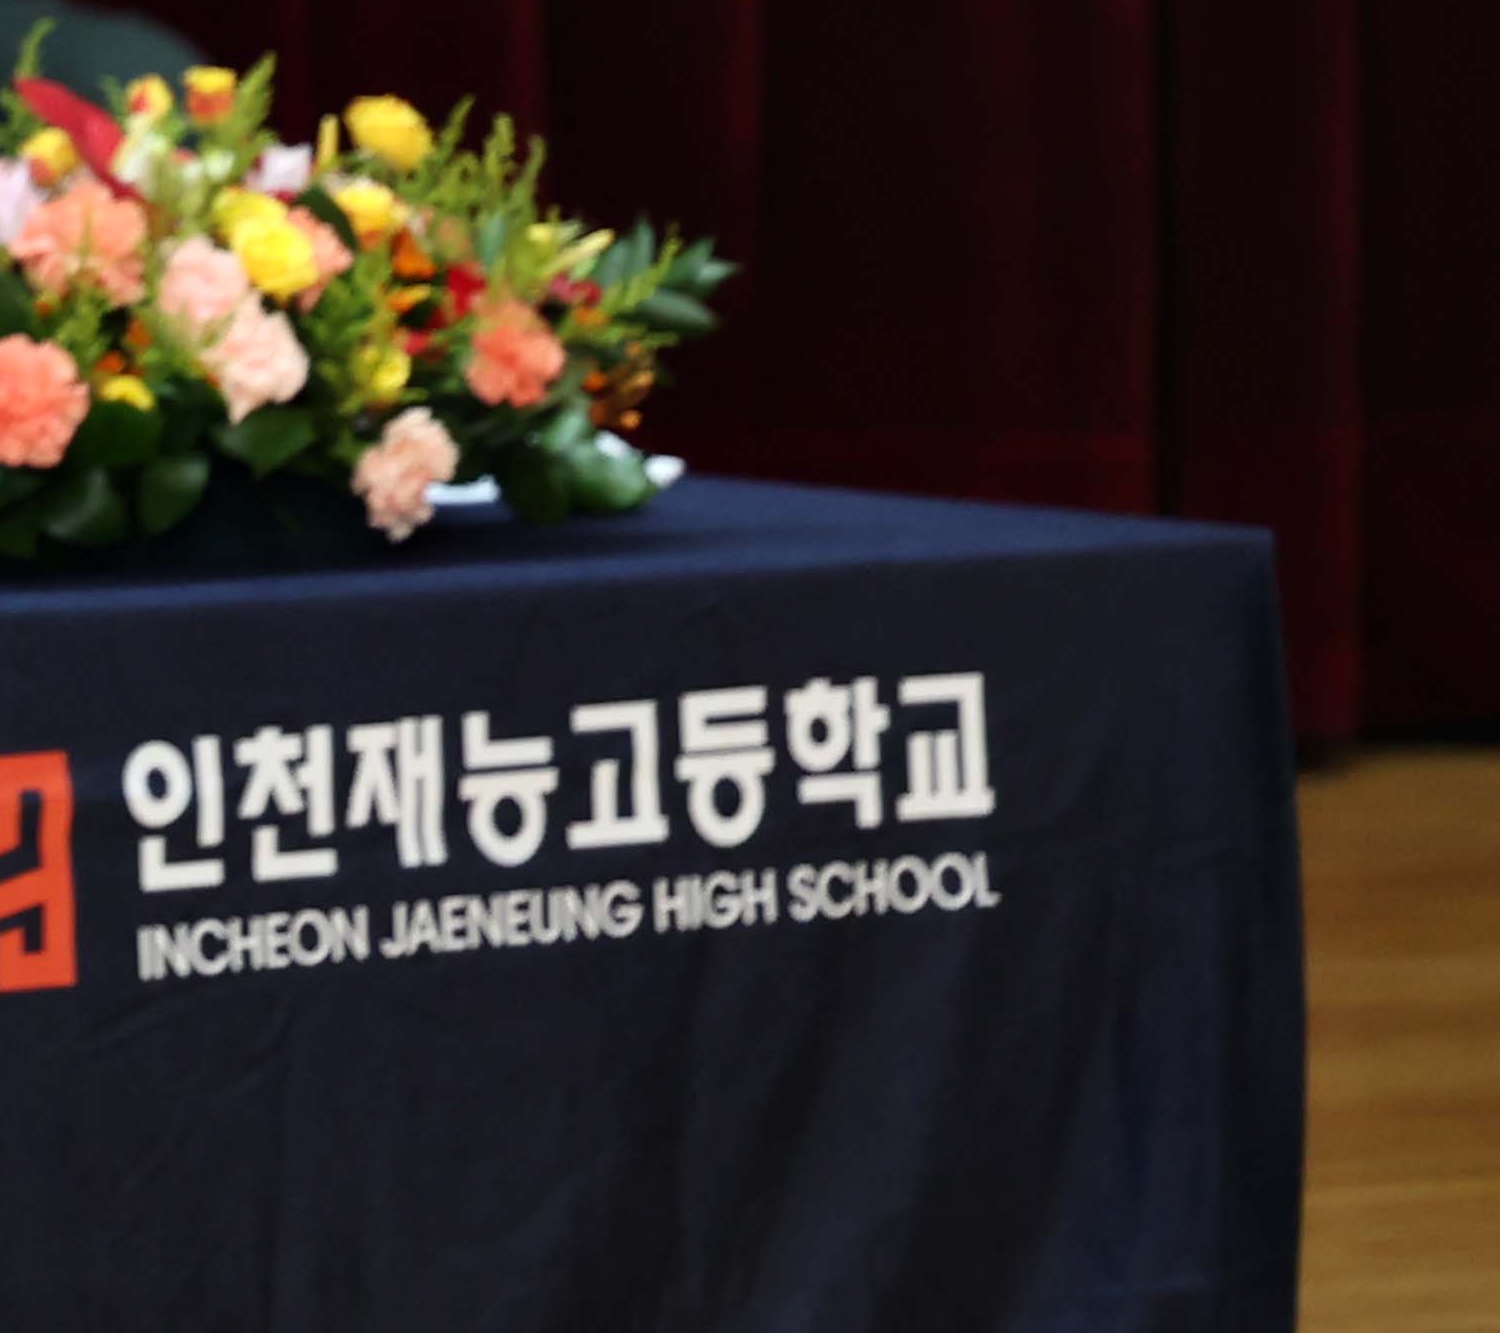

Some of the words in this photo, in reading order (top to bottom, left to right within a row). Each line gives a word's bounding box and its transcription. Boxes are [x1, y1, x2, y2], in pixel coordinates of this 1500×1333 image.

[121, 671, 996, 893] 인천재능고등학교
[136, 905, 371, 982] INCHEON
[379, 879, 644, 959] JAENEUNG
[652, 869, 779, 933] HIGH
[787, 851, 1000, 923] SCHOOL
